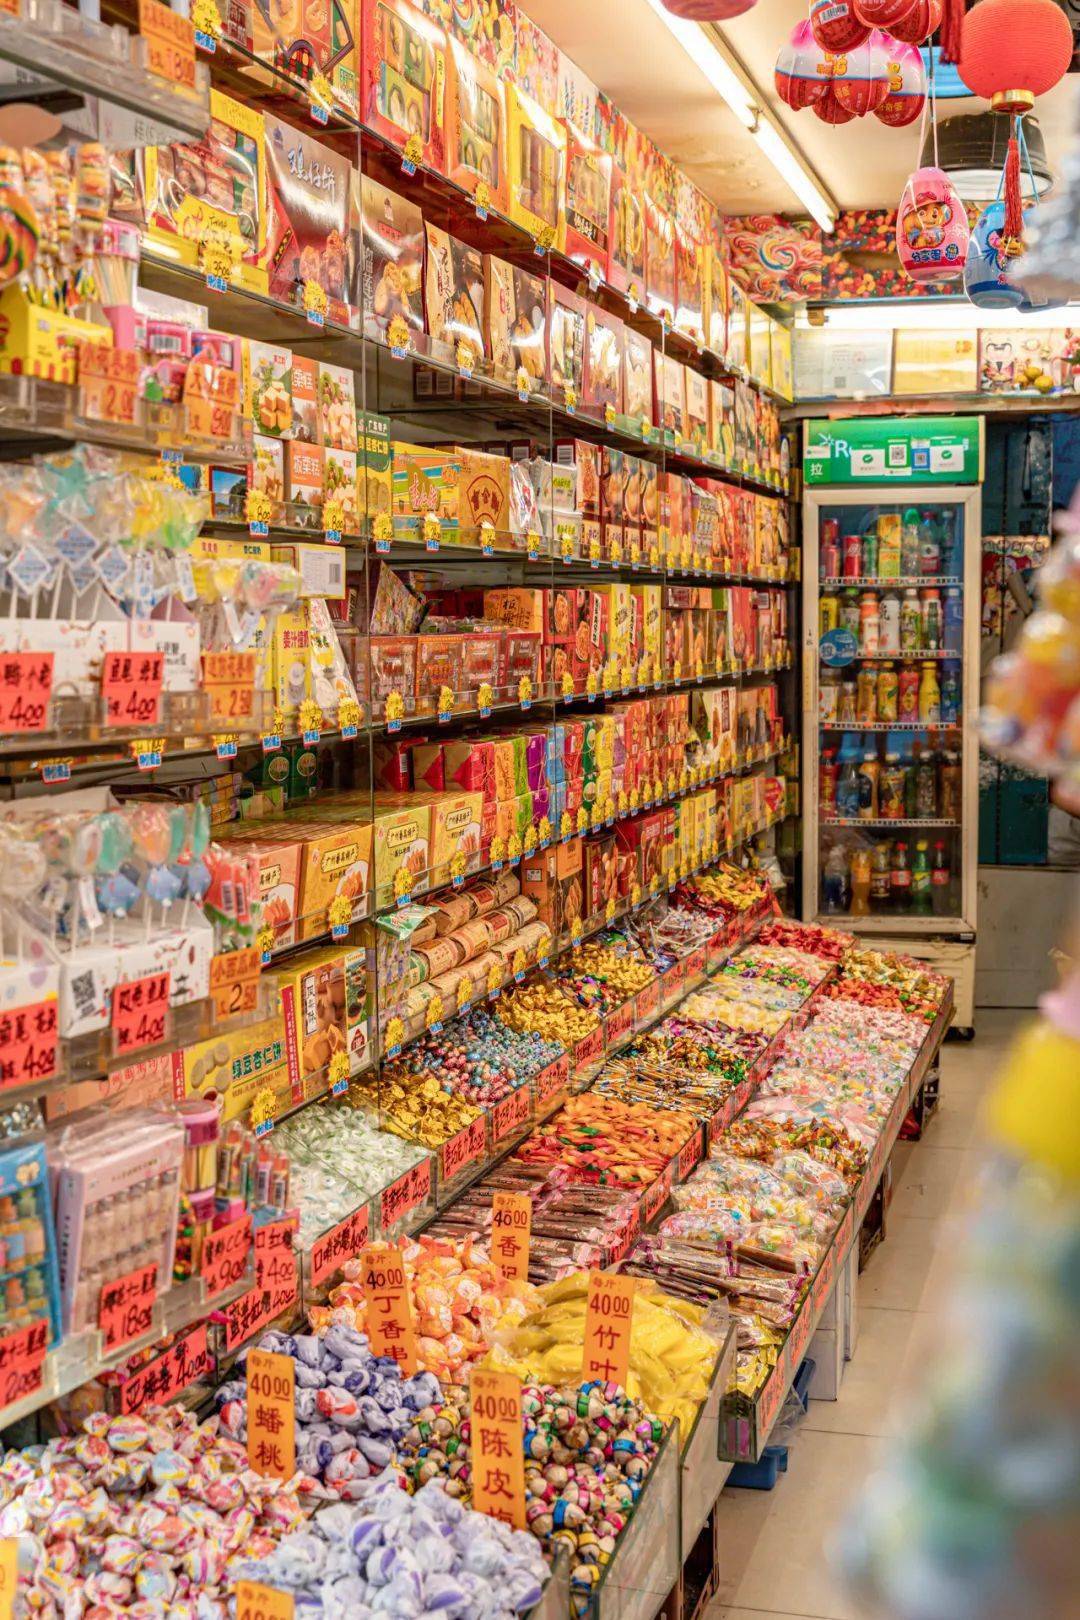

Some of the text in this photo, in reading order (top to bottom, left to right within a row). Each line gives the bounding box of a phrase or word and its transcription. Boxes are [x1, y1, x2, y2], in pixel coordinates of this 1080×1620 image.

[834, 440, 853, 458] R
[810, 463, 823, 477] 拉
[126, 691, 156, 720] 4.00
[232, 1040, 283, 1080] 绿豆杏仁饼
[369, 1296, 409, 1379] 丁香串
[589, 1325, 621, 1383] 竹叶
[255, 1404, 285, 1471] 蟠桃
